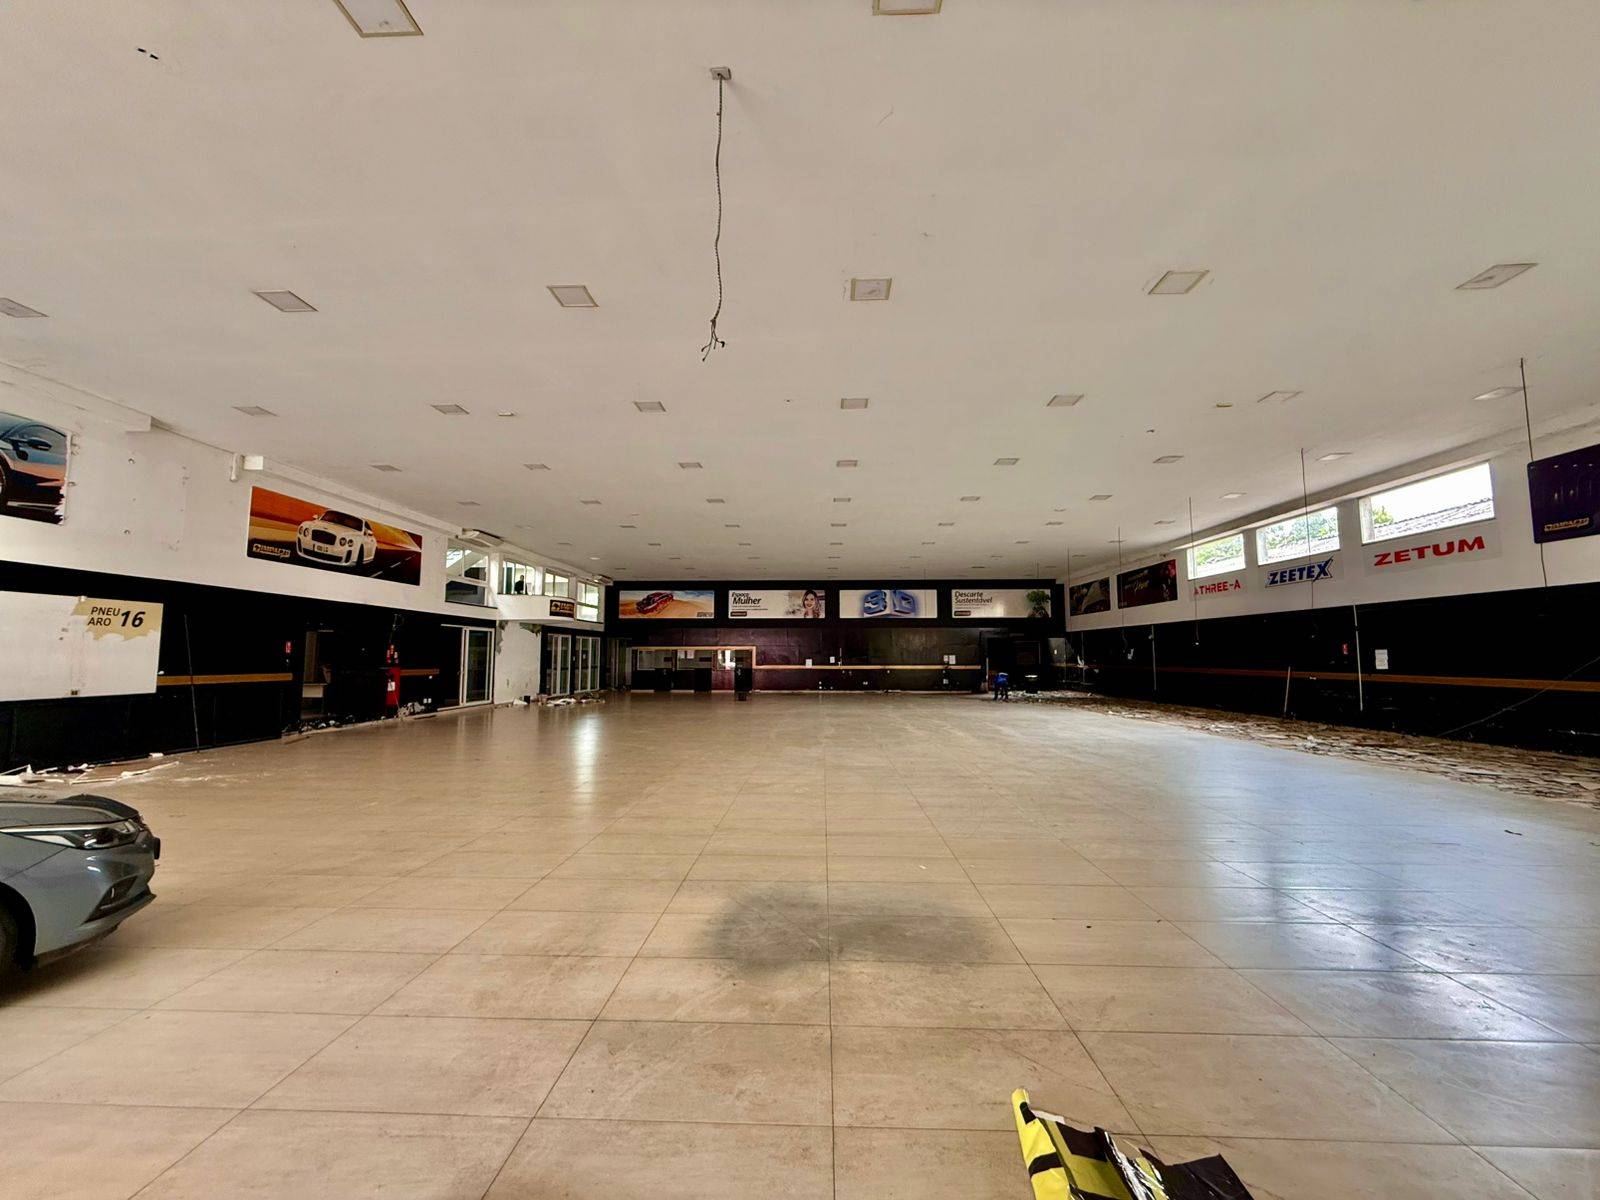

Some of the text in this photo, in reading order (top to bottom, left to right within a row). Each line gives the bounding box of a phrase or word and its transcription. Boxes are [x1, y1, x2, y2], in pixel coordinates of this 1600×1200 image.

[1374, 536, 1485, 566] ZETUM
[1268, 556, 1333, 585] ZEETEX
[1199, 580, 1241, 595] THREE-A
[732, 596, 761, 604] Mulher
[91, 606, 121, 616] PNEU
[121, 610, 146, 627] 16
[87, 617, 112, 627] ARO
